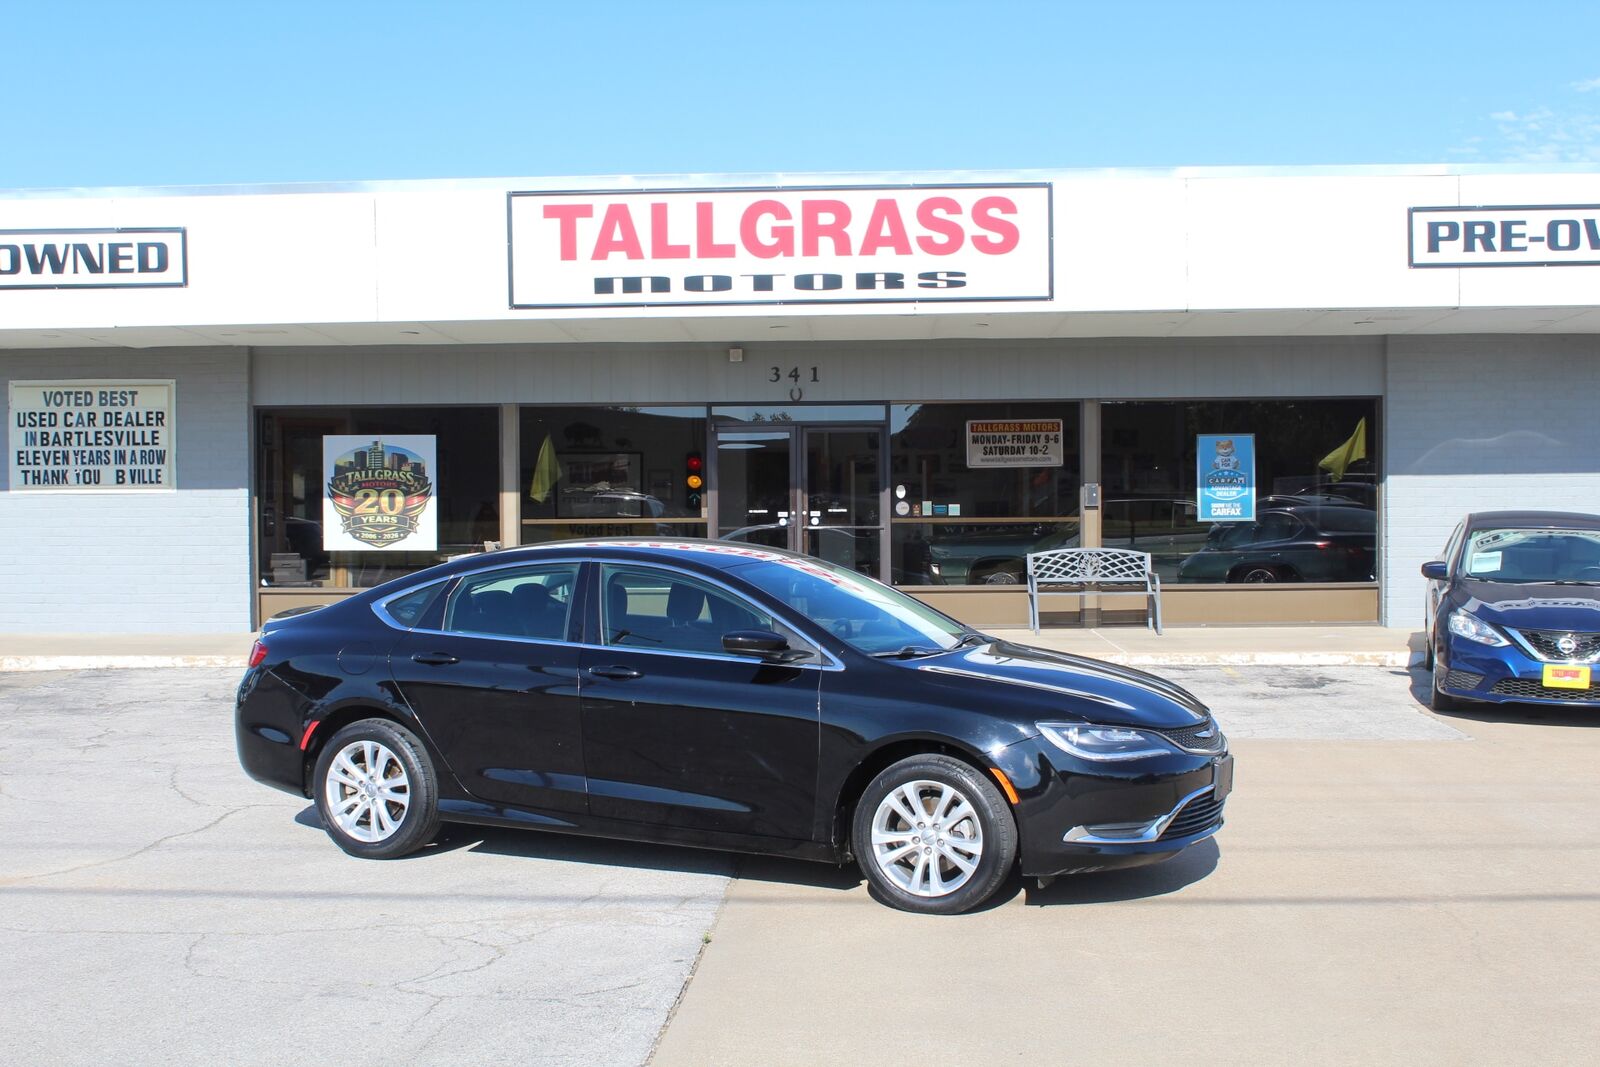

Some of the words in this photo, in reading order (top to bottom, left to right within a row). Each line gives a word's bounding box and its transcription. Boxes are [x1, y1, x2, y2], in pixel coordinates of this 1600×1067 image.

[543, 196, 1020, 261] TALLGRASS
[0, 242, 169, 275] OWNED
[593, 271, 967, 295] MOTORS
[769, 366, 820, 382] 341
[43, 390, 93, 407] VOTED
[98, 390, 138, 407] BEST
[17, 412, 58, 428] USED
[64, 411, 97, 428] CAR
[104, 411, 165, 427] DEALER
[972, 423, 1020, 432] TALLGRASS
[1023, 423, 1059, 432] MOTORS
[25, 431, 37, 446] IN
[41, 430, 160, 446] BARTLESVILLE
[972, 434, 1042, 444] MONDAY-FRIDAY
[1045, 434, 1060, 444] 9-6
[17, 450, 70, 466] ELEVEN
[73, 449, 111, 465] YEARS
[114, 449, 126, 465] IN
[130, 450, 138, 465] A
[140, 449, 166, 465] ROW
[983, 445, 1026, 456] SATURDAY
[1029, 445, 1049, 455] 10-2
[21, 469, 69, 485] THANK
[74, 469, 100, 485] YOU
[116, 469, 126, 485] B
[130, 469, 162, 484] VILLE
[345, 469, 415, 485] TALLGRASS
[353, 488, 405, 515] 20
[361, 515, 398, 524] YEARS
[1211, 508, 1242, 516] CARFAX
